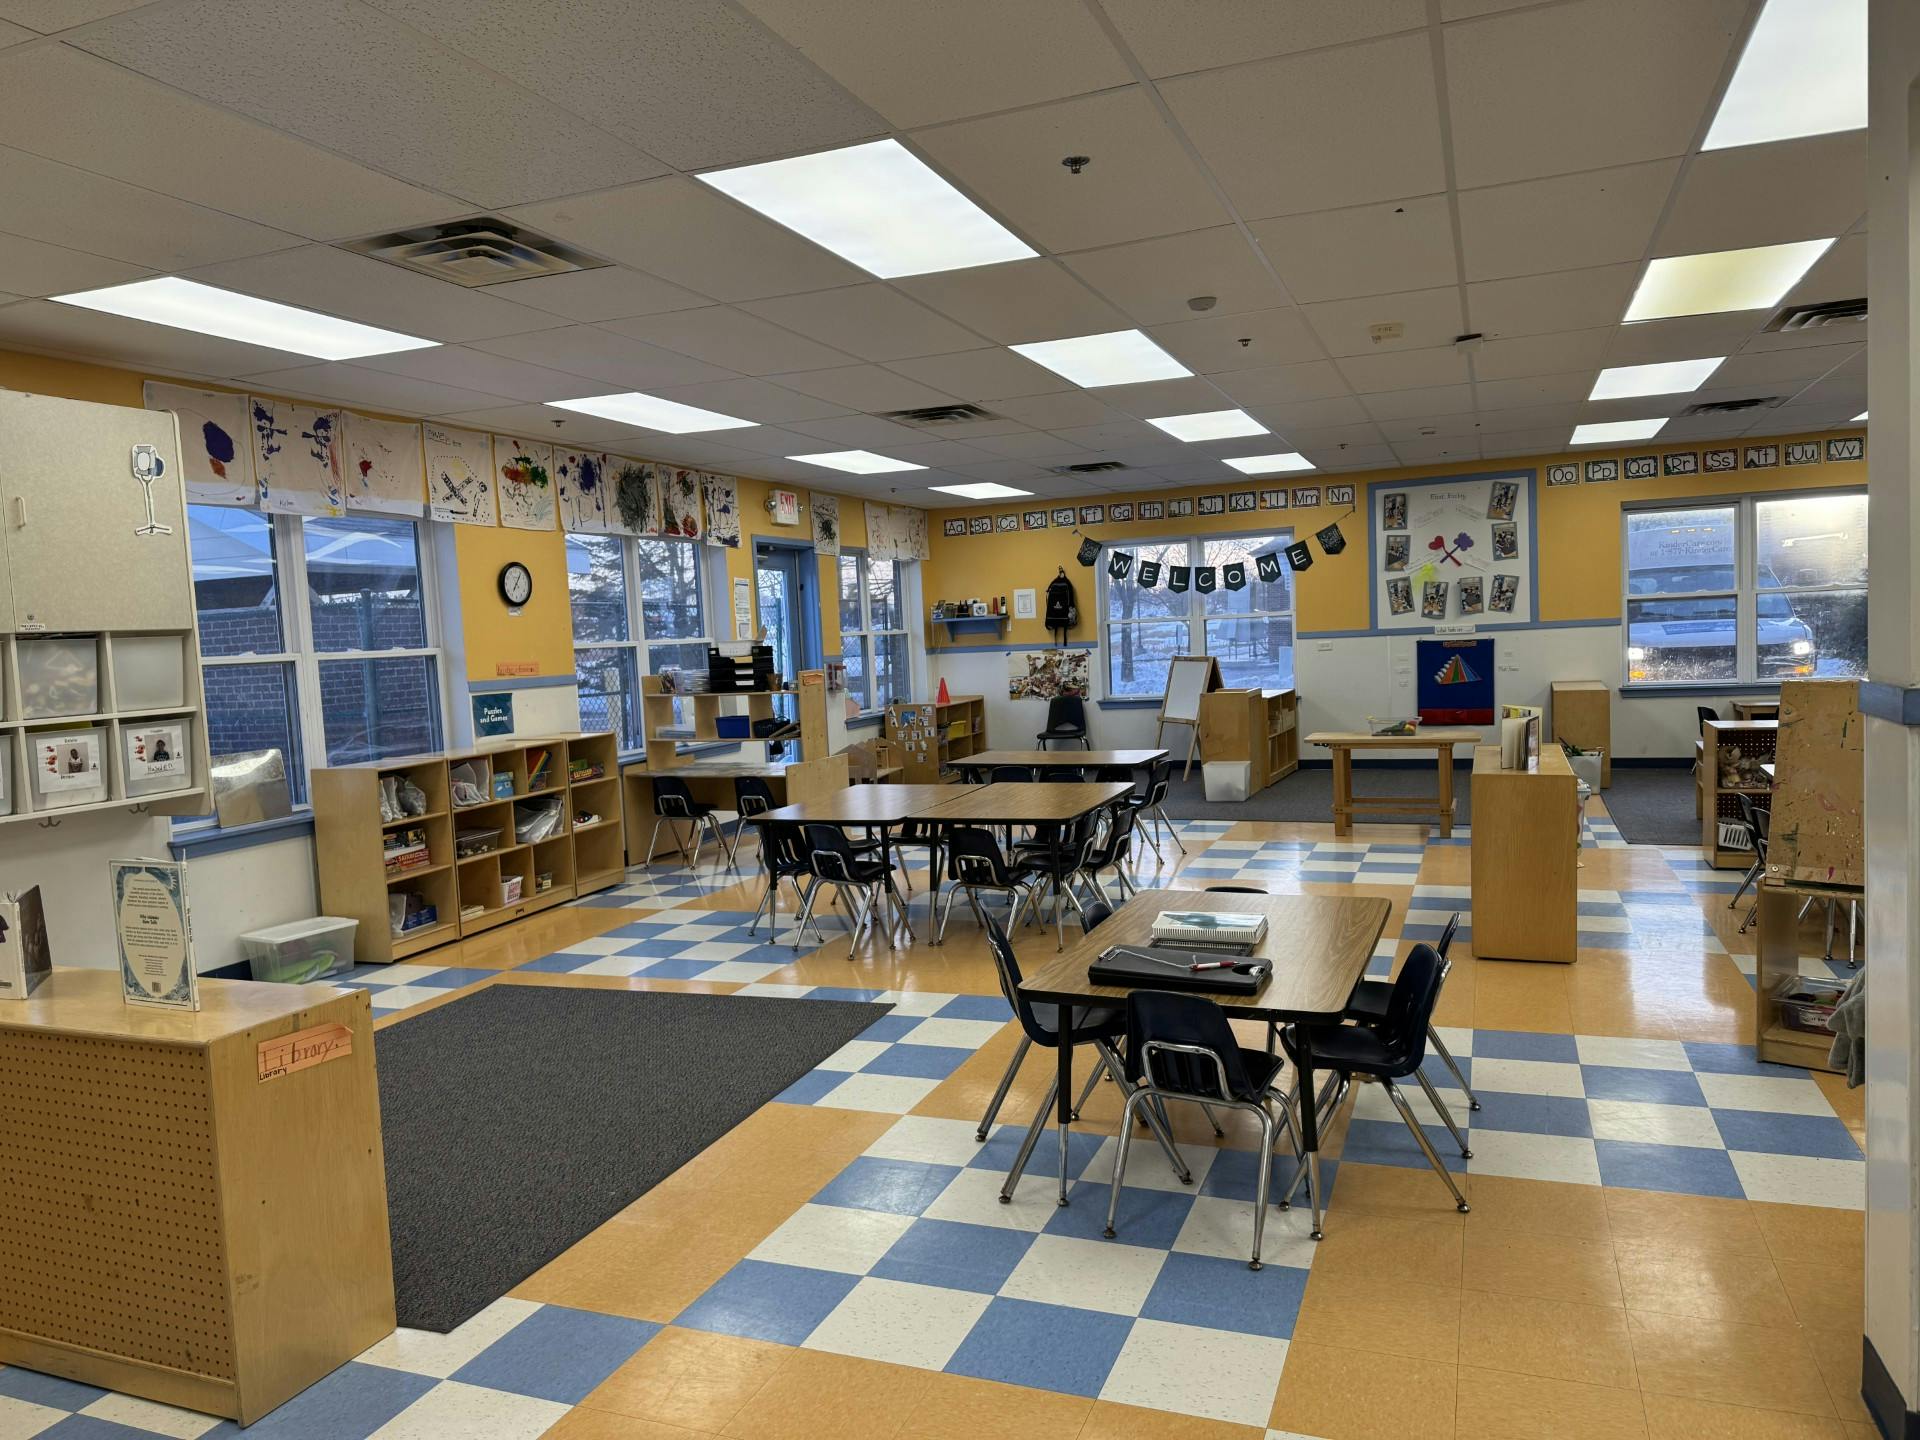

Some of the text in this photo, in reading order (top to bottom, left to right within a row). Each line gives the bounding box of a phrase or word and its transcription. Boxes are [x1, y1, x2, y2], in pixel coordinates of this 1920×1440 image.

[1791, 446, 1815, 461] Uu
[1833, 441, 1856, 457] Vv
[1710, 452, 1731, 468] Ss
[1756, 449, 1769, 464] Tt
[1591, 464, 1612, 478] Pp
[1628, 460, 1651, 476] Qq
[1671, 457, 1691, 471] Rr
[1552, 467, 1574, 482] Oo
[780, 492, 795, 505] EXIT
[1234, 495, 1251, 509] Kk
[1295, 491, 1318, 505] Mm
[1330, 489, 1351, 502] Nn
[1143, 503, 1161, 517] Hh
[1205, 497, 1218, 512] Jj
[1028, 514, 1044, 527] Dd
[1085, 507, 1099, 521] Ff
[1112, 506, 1130, 521] Gg
[948, 521, 963, 533] Aa
[974, 519, 989, 532] Bb
[1000, 517, 1016, 530] Cc
[1112, 549, 1307, 587] WELCOME
[483, 706, 502, 715] Puzzles
[479, 714, 508, 724] and Games
